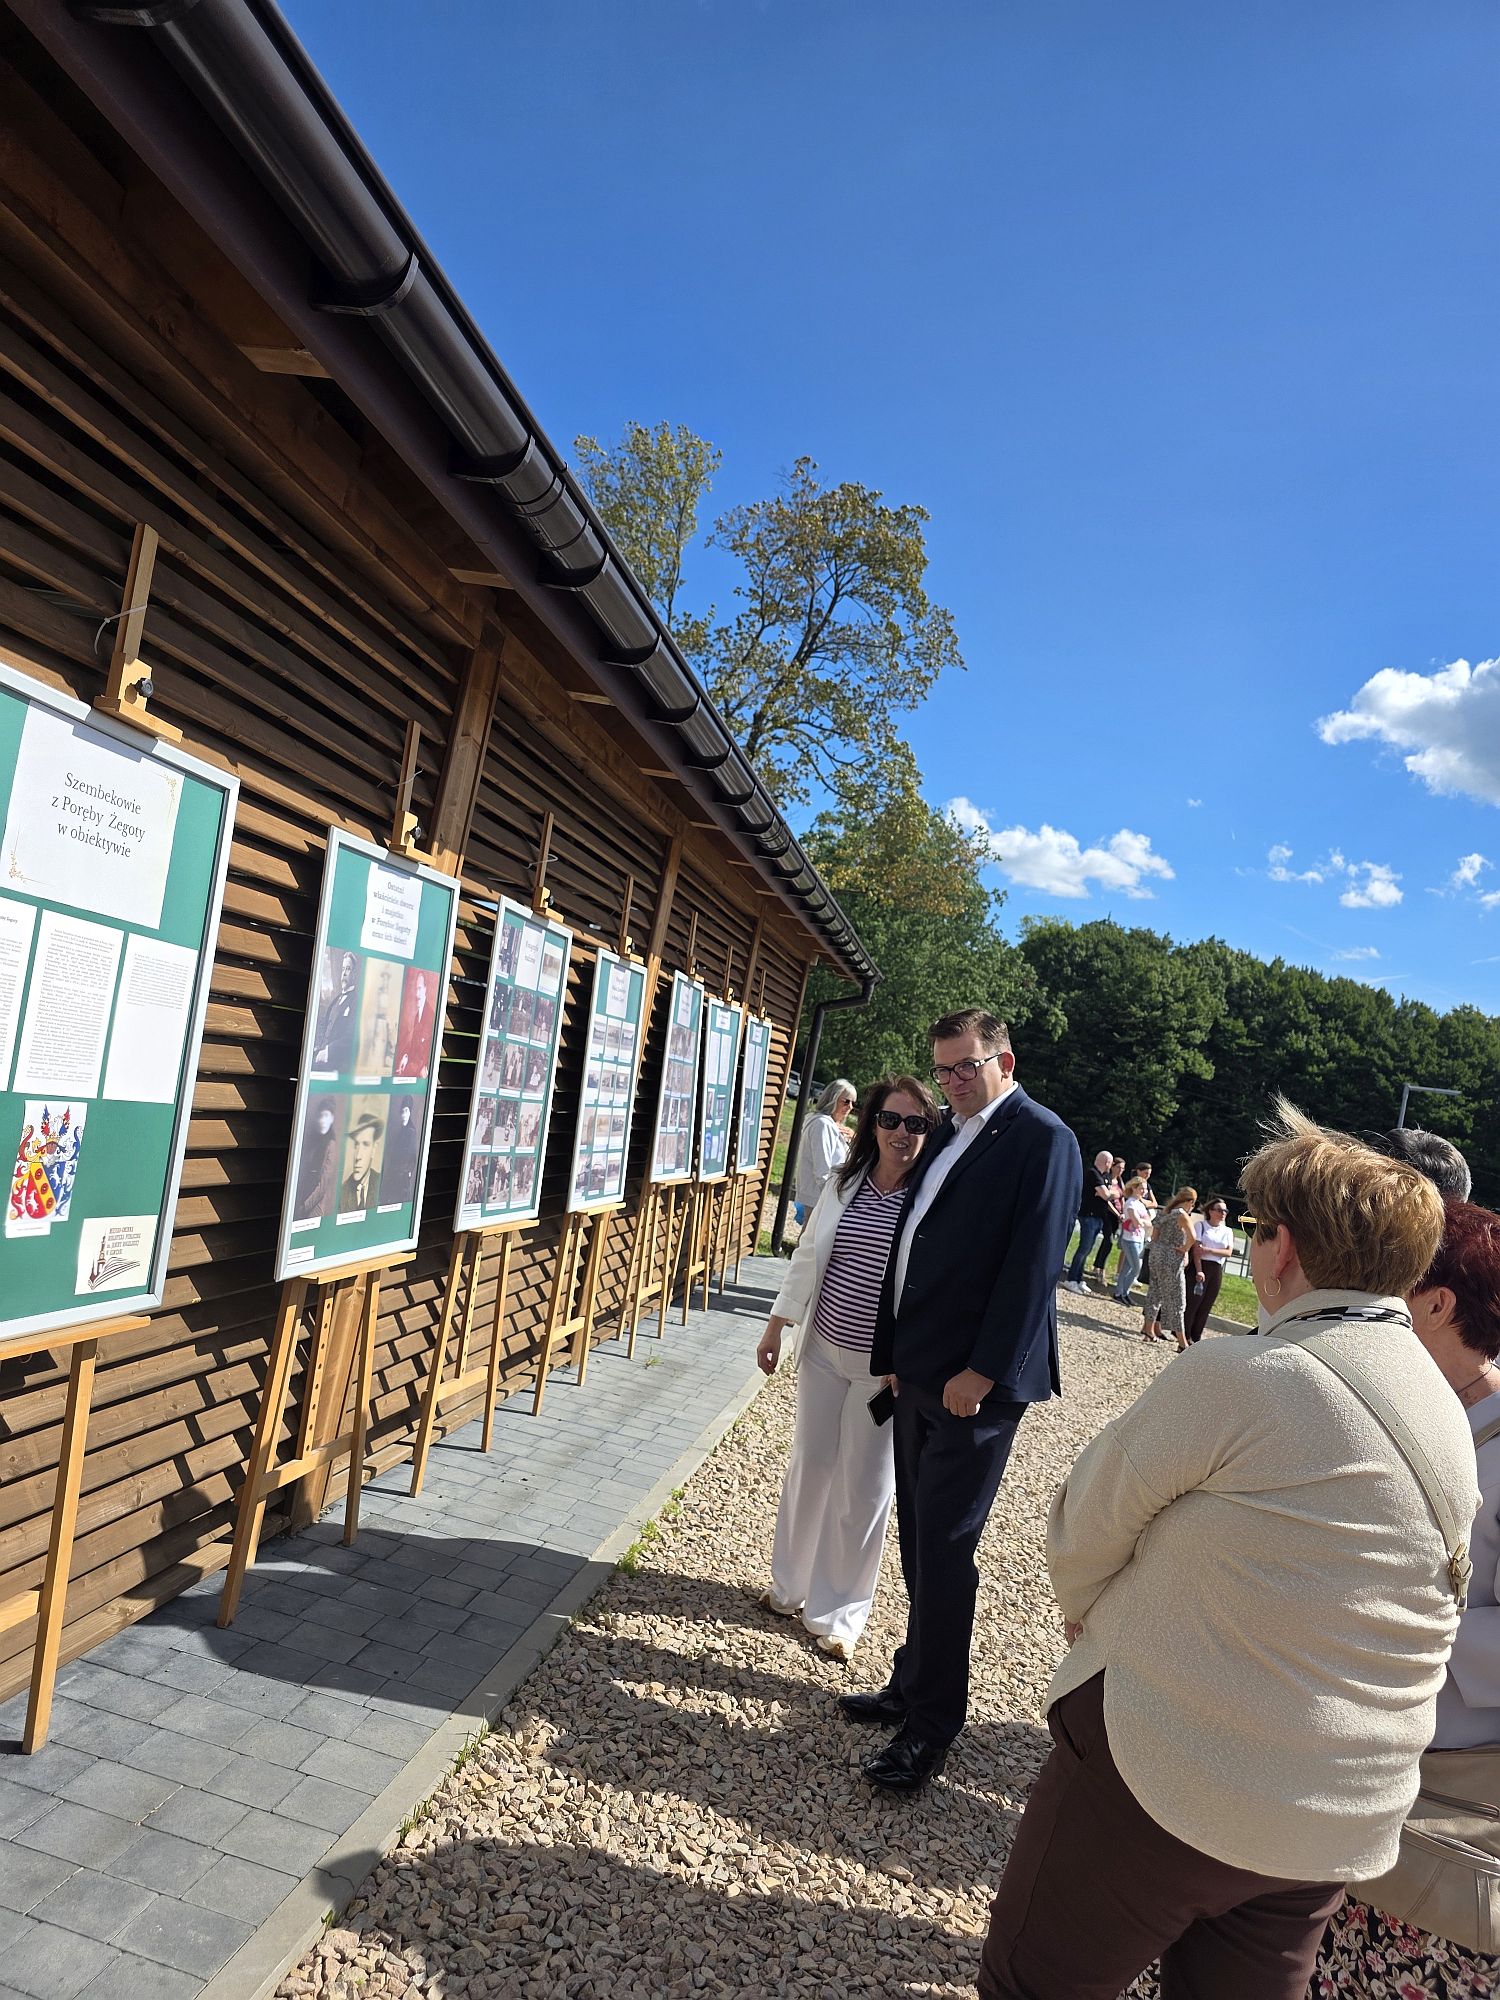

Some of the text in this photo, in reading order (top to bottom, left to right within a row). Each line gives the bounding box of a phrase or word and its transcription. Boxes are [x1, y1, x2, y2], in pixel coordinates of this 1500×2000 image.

[64, 772, 141, 815] Szembekowie
[51, 796, 146, 843] z Poręby Żegoty
[57, 823, 131, 858] w obiektywie
